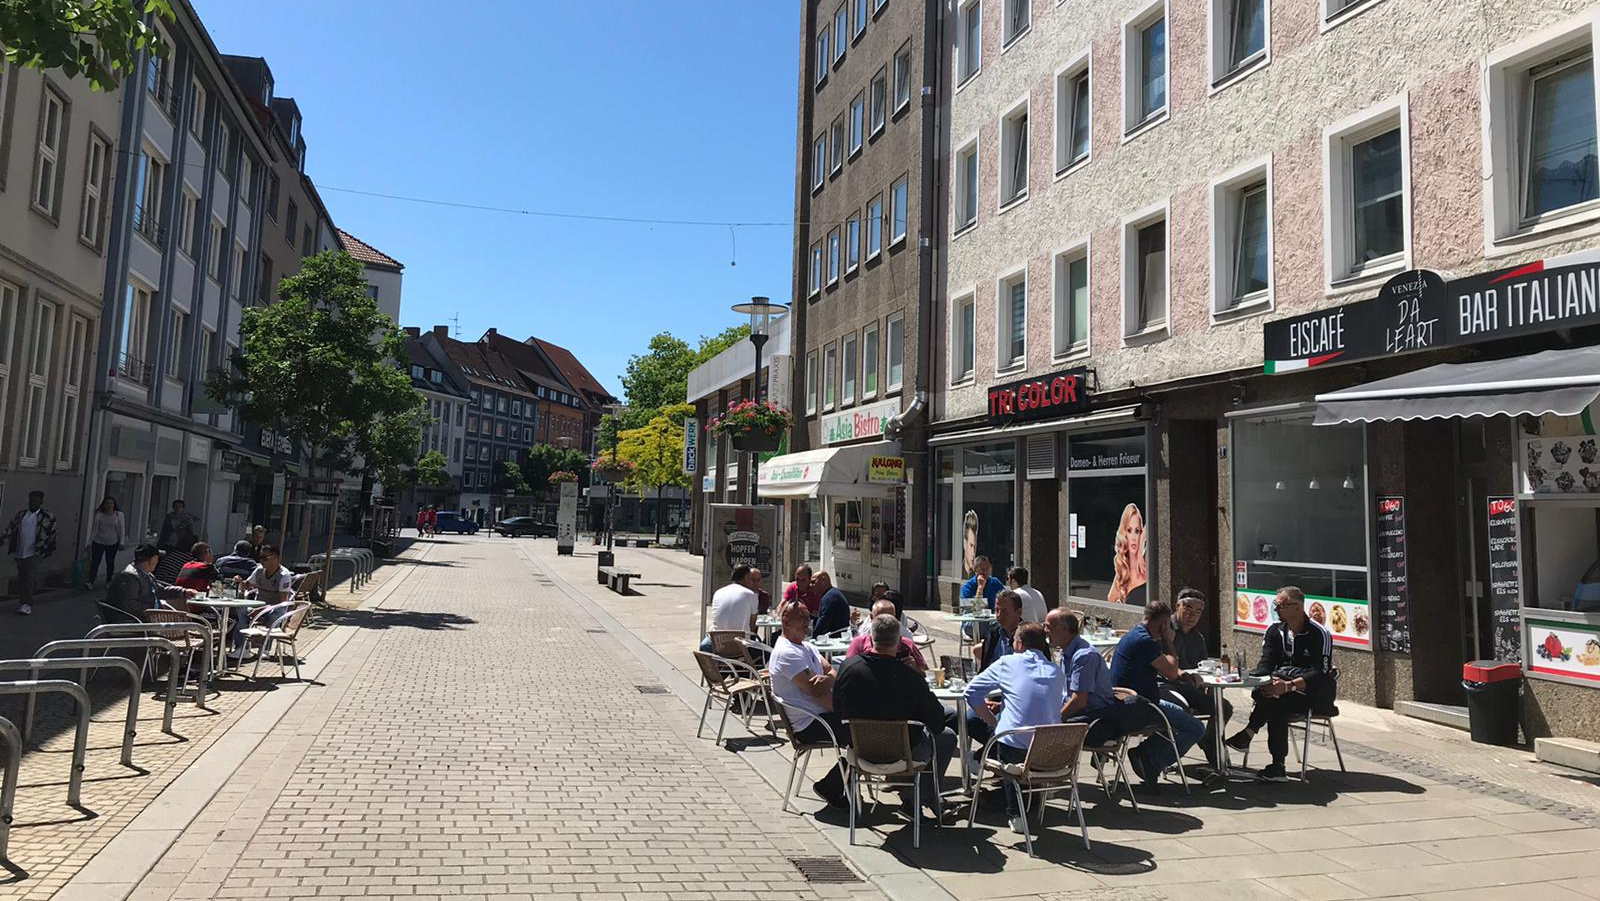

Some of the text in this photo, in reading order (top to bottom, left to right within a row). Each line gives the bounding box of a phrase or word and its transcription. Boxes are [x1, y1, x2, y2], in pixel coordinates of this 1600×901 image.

[1391, 280, 1428, 294] VENEZIA
[1398, 297, 1420, 325] DA
[1459, 268, 1600, 335] BAR ITALIAN
[1290, 308, 1345, 357] EISCAFÉ
[1386, 318, 1439, 353] LEART
[988, 375, 1077, 416] TRI COLOR
[836, 412, 880, 440] Asia Bistro
[1070, 452, 1141, 468] Damen- & Herren Friseur
[730, 543, 758, 553] HOPFEN
